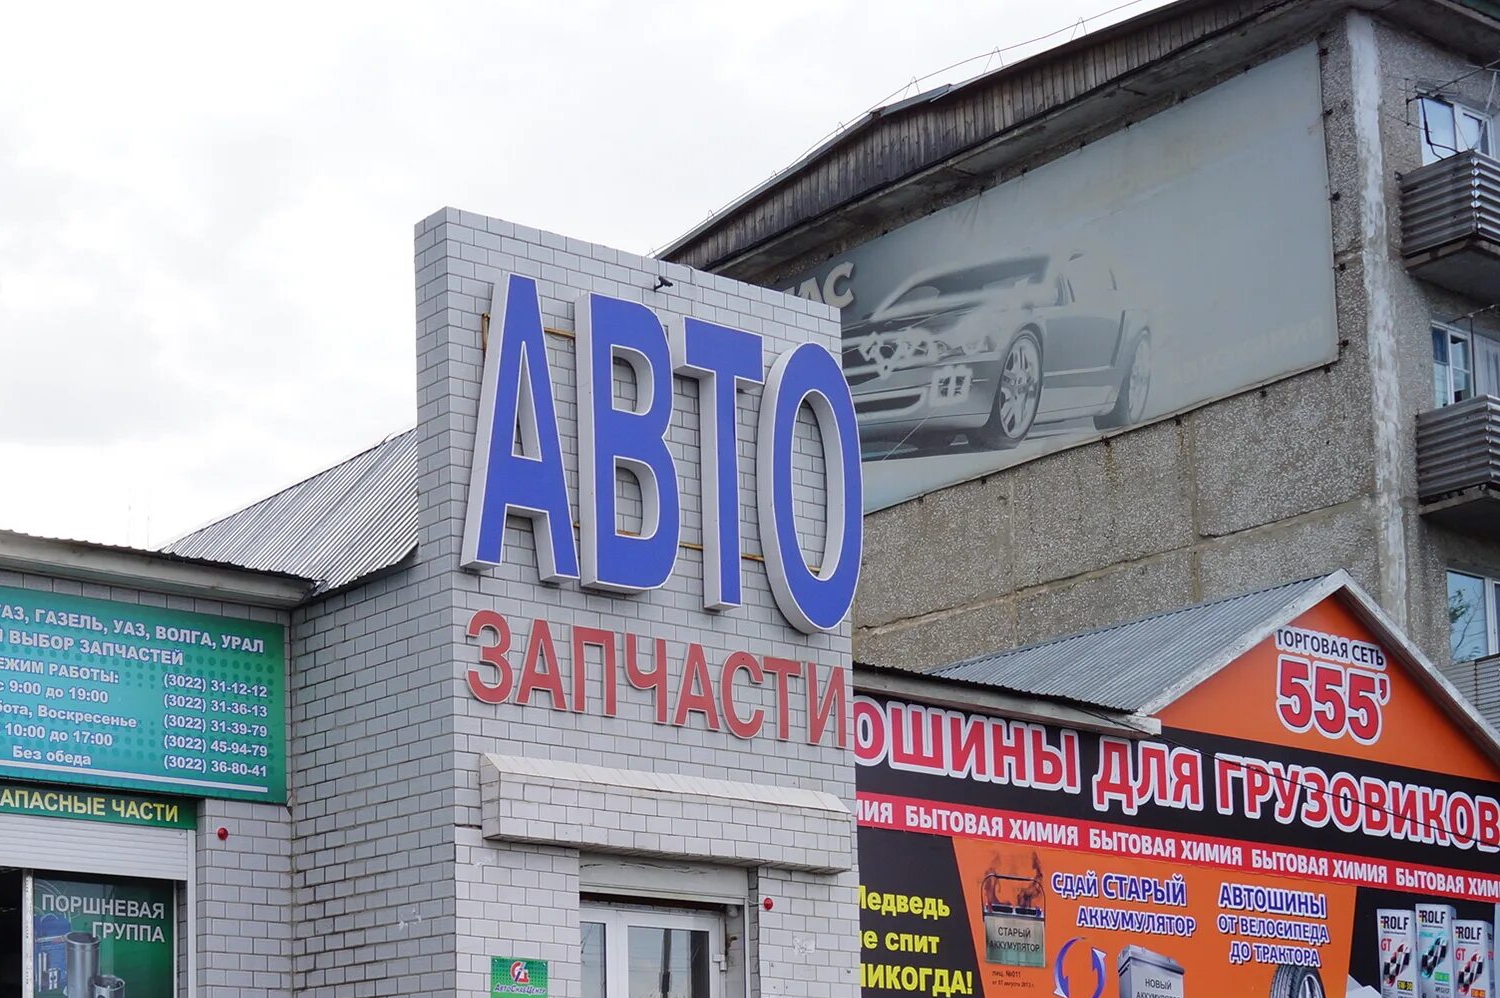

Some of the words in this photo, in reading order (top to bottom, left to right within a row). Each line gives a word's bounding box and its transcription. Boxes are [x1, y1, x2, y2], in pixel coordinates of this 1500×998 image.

[460, 272, 863, 634] АВТО
[35, 607, 103, 634] ГАЗЕЛЬ,
[113, 619, 149, 640] УАЗ,
[155, 625, 216, 649] ВОЛГА,
[220, 634, 265, 654] УРАЛ
[8, 628, 75, 651] ВЫБОР
[79, 635, 184, 666] ЗАПЧАСТЕЙ
[1276, 628, 1349, 659] ТОРГОВАЯ
[1352, 644, 1385, 667] СЕТЬ
[48, 662, 120, 685] РАБОТЫ:
[163, 673, 207, 693] (3022)
[210, 679, 268, 698] 31-12-12
[464, 609, 848, 748] ЗАПЧАСТИ
[8, 679, 41, 697] 9:00
[44, 687, 65, 702] до
[68, 686, 110, 704] 19:00
[37, 703, 138, 729] Воскресенье
[163, 693, 207, 713] (3022)
[210, 699, 268, 718] 31-36-13
[3, 720, 45, 740] 10:00
[49, 728, 69, 744] до
[72, 728, 114, 746] 17:00
[163, 714, 207, 734] (3022)
[210, 720, 268, 739] 31-39-79
[12, 744, 41, 762] Без
[45, 747, 92, 768] обеда
[163, 734, 207, 754] (3022)
[210, 740, 268, 759] 45-94-79
[163, 754, 207, 774] (3022)
[210, 760, 268, 779] 36-80-41
[1092, 737, 1204, 816] ДЛЯ
[1214, 751, 1500, 854] ГРУЗОВИКОВ
[111, 799, 179, 823] ЧАСТИ
[905, 805, 1003, 838] БЫТОВАЯ
[1009, 818, 1079, 847] ХИМИЯ
[1089, 827, 1176, 858] БЫТОВАЯ
[1180, 839, 1243, 867] ХИМИЯ
[1251, 848, 1329, 877] БЫТОВАЯ
[1332, 859, 1388, 884] ХИМИЯ
[1395, 867, 1465, 894] БЫТОВАЯ
[1467, 877, 1500, 899] ХИМ
[1051, 870, 1098, 899] СДАЙ
[1102, 873, 1187, 907] СТАРЫЙ
[1218, 882, 1327, 918] АВТОШИНЫ
[42, 893, 165, 919] ПОРШНЕВАЯ
[1421, 910, 1446, 924] ROLF
[92, 922, 165, 943] ГРУППА
[998, 926, 1031, 938] СТАРЫЙ
[1076, 905, 1196, 938] АККУМУЛЯТОР
[1217, 915, 1239, 934] ОТ
[1240, 917, 1331, 945] ВЕЛОСИПЕДА
[1383, 916, 1409, 930] ROLF
[1457, 926, 1482, 940] ROLF
[885, 931, 940, 954] спит
[988, 939, 1040, 952] АККУМУЛЯТОР
[1230, 941, 1252, 963] ДО
[1254, 944, 1320, 968] ТРАКТОРА
[1381, 938, 1392, 951] GT
[1455, 948, 1466, 961] GT
[1144, 977, 1172, 990] НОВЫЙ
